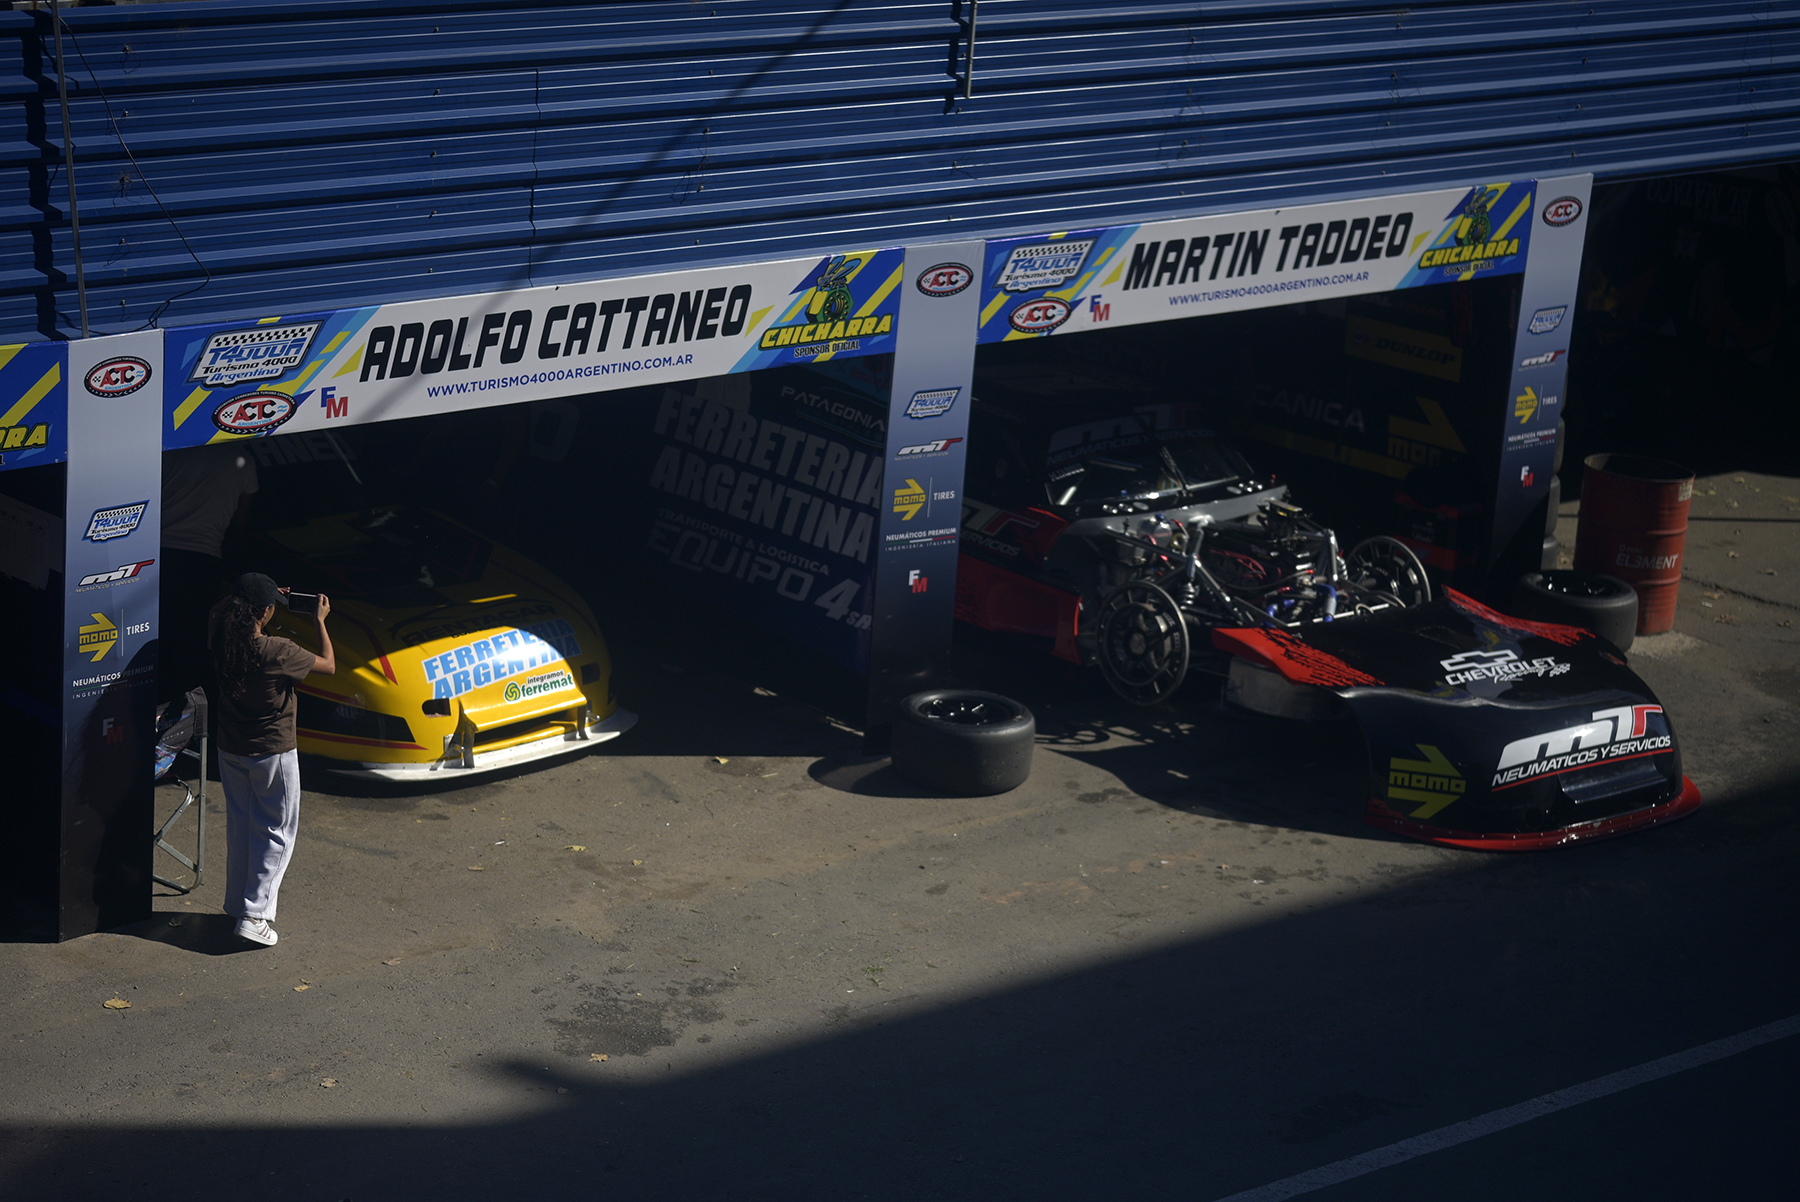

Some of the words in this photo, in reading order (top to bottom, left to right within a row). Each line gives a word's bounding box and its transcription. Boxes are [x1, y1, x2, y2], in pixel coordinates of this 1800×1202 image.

[1122, 229, 1270, 291] MARTIN
[1275, 212, 1413, 272] TADDEO
[1419, 237, 1519, 269] CHICHARRA
[928, 270, 960, 288] ACTC
[1004, 272, 1047, 282] Turismo
[1048, 267, 1076, 276] 4000
[1169, 271, 1369, 306] WWW.TURISMO4000ARGENTINO.COM.AR
[1021, 304, 1057, 324] ACTC
[359, 309, 533, 384] ADOLFO
[538, 284, 753, 360] CATTANEO
[760, 314, 893, 350] CHICHARRA
[794, 343, 830, 359] SPONSOR
[832, 339, 860, 353] OFICIAL
[1375, 336, 1456, 366] DUNLOP
[99, 365, 136, 388] ACTC
[202, 361, 260, 375] Turismo
[261, 355, 298, 367] 4000
[209, 367, 280, 382] Argentino
[427, 353, 694, 399] WWW.TURISMO4000ARGENTINO.COM.AR
[231, 399, 277, 424] ACTC
[237, 417, 273, 427] ARGENTINA
[781, 385, 887, 433] PATAGONIA
[653, 387, 885, 510] FERRETERIA
[1046, 436, 1140, 467] NEUMATICOS
[649, 445, 875, 565] ARGENTINA
[933, 490, 955, 501] TIRES
[658, 508, 743, 546] TRANSPORTE
[757, 543, 830, 576] LOGISTICA
[885, 530, 927, 542] NEUMÁTICOS
[927, 527, 956, 537] PREMIUM
[926, 539, 956, 547] ITALIANA
[646, 520, 779, 602] EQUIPO
[126, 622, 151, 636] TIRES
[422, 618, 576, 681] FERRETERIA
[72, 671, 122, 688] NEUMÁTICOS
[122, 664, 155, 677] PREMIUM
[435, 636, 581, 700] ARGENTINA
[527, 669, 564, 684] integramos
[1445, 656, 1555, 686] CHEVROLET
[72, 686, 118, 699] INGENIERÍA
[121, 679, 154, 690] ITALIANA
[521, 675, 574, 698] ferremat
[1491, 747, 1599, 788] NEUMATICOS
[1600, 745, 1611, 760] Y
[1609, 733, 1672, 758] SERVICIOS
